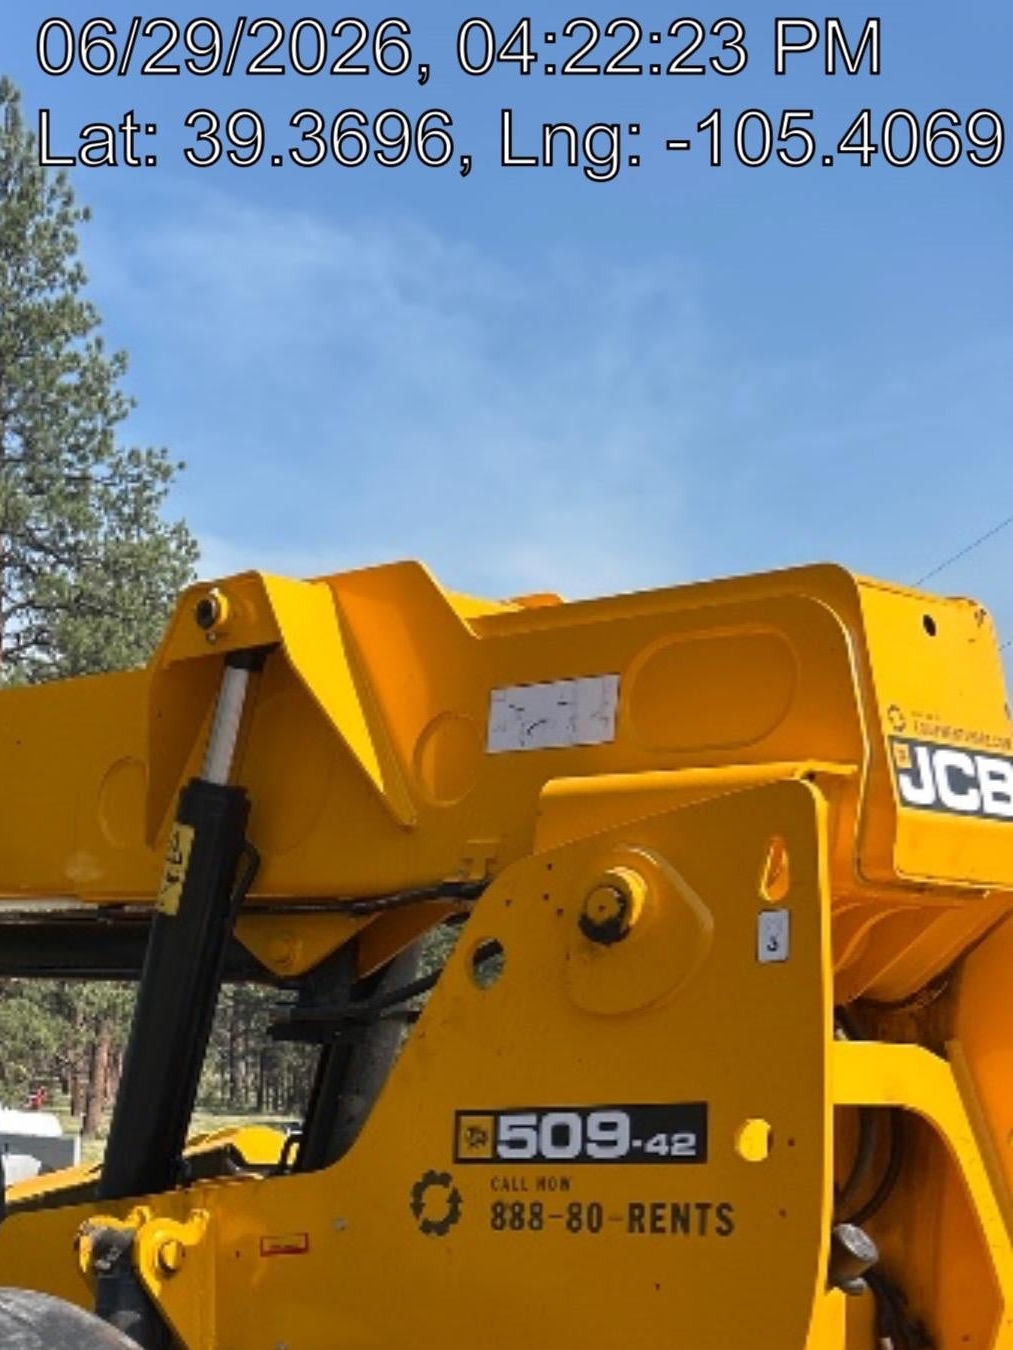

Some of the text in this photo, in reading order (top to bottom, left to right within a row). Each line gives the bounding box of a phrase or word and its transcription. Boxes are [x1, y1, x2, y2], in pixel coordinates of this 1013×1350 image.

[898, 745, 1013, 817] JCB
[496, 1109, 698, 1159] 509-42
[490, 1175, 529, 1192] CALL
[490, 1200, 735, 1237] 888-80-RENTS
